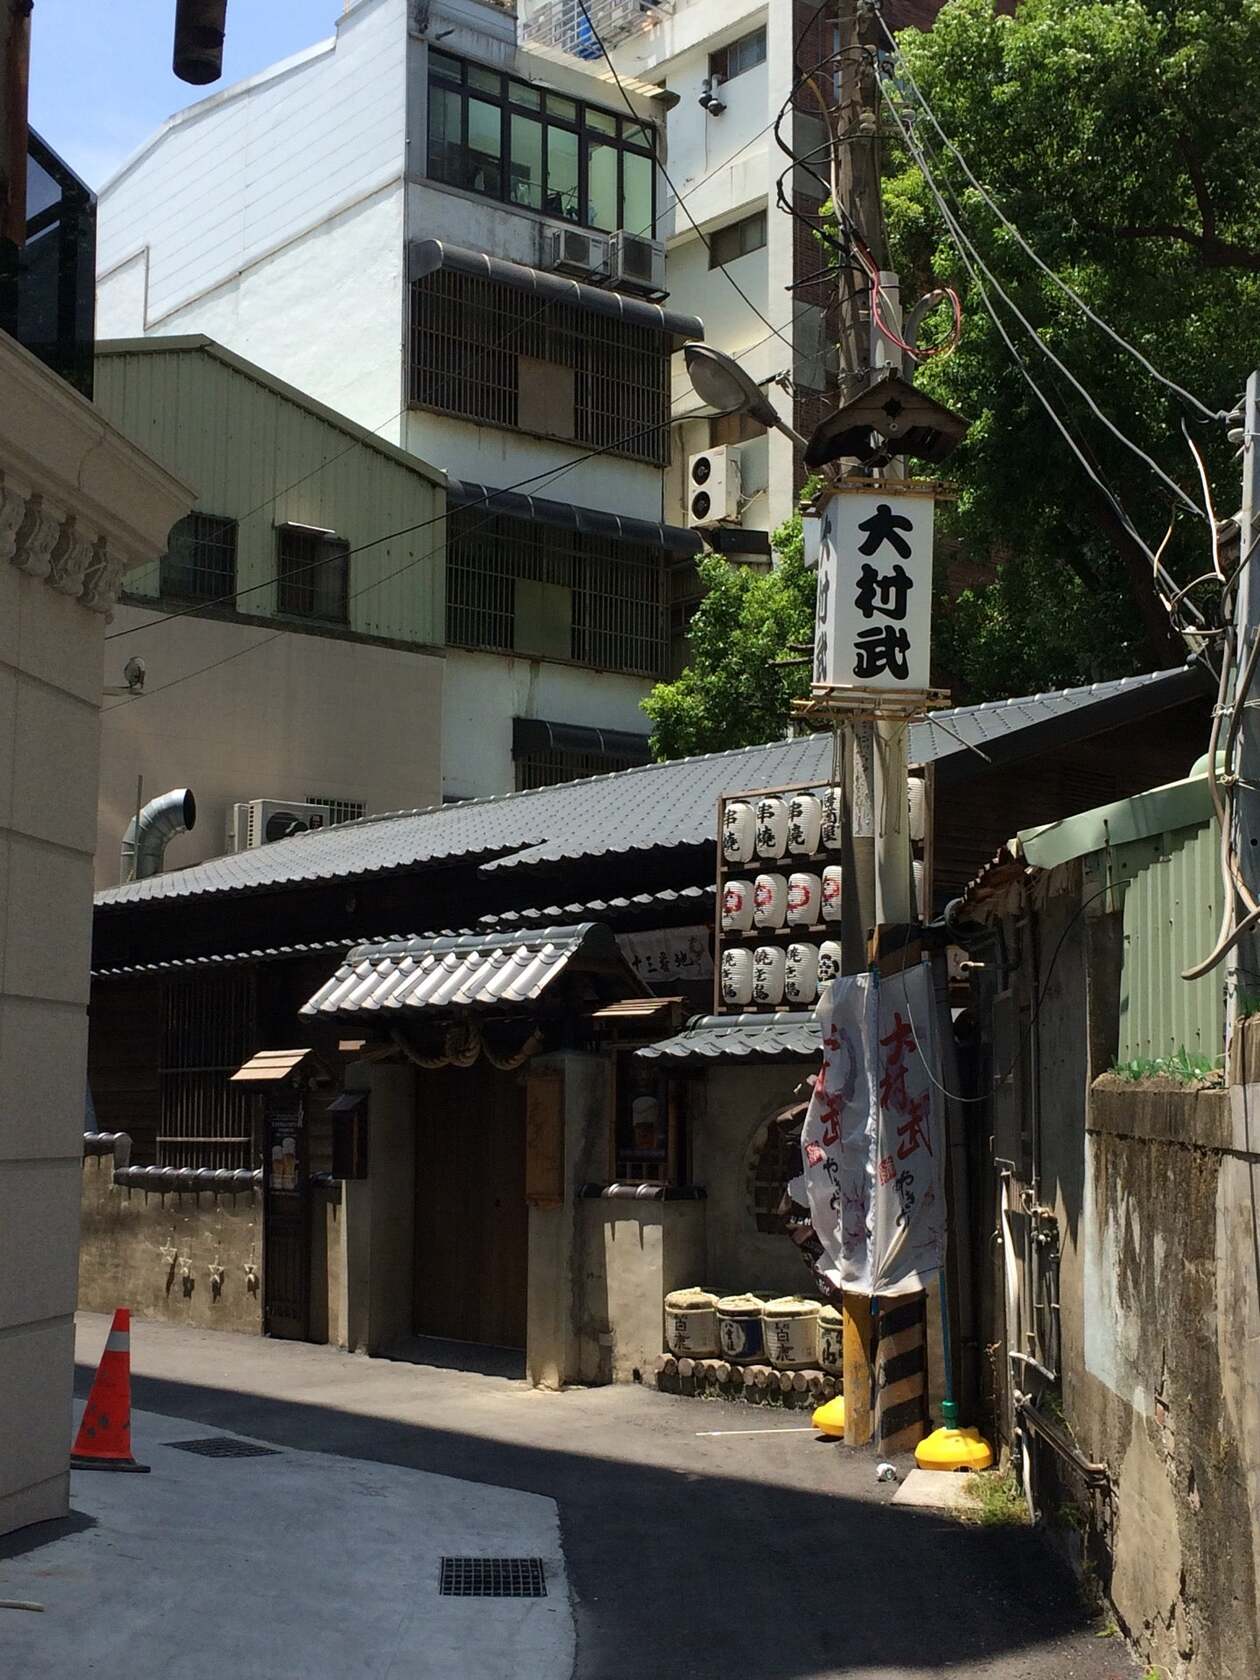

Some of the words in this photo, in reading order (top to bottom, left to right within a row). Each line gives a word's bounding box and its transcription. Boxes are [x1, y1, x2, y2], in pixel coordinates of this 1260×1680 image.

[853, 503, 914, 680] 大村武
[757, 802, 776, 848] 串燒
